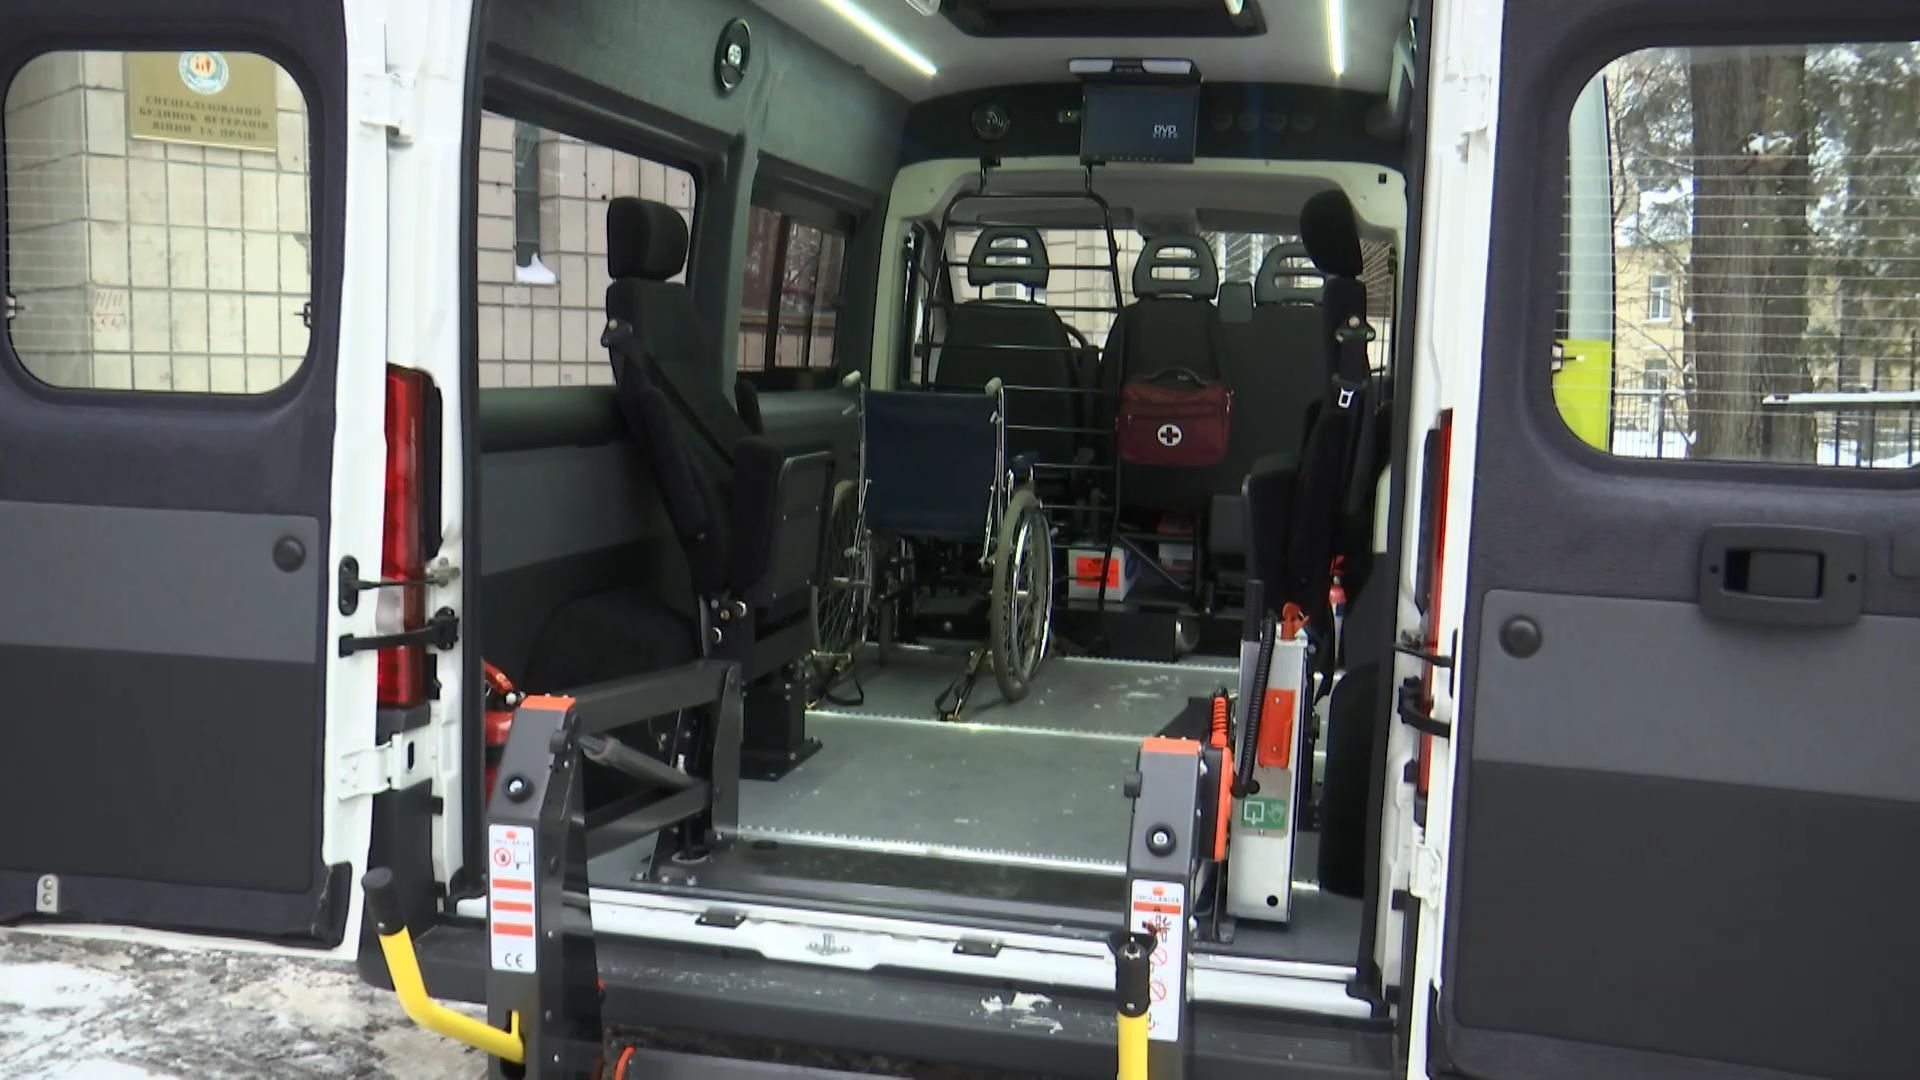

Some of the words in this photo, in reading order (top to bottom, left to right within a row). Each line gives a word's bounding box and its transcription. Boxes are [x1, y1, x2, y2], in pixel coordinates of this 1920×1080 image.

[139, 106, 197, 122] БУДИНОК
[204, 115, 269, 130] ВЕТЕРАНІВ
[200, 126, 214, 137] ТА
[219, 128, 257, 141] ПРАЦІ
[504, 952, 524, 969] CE
